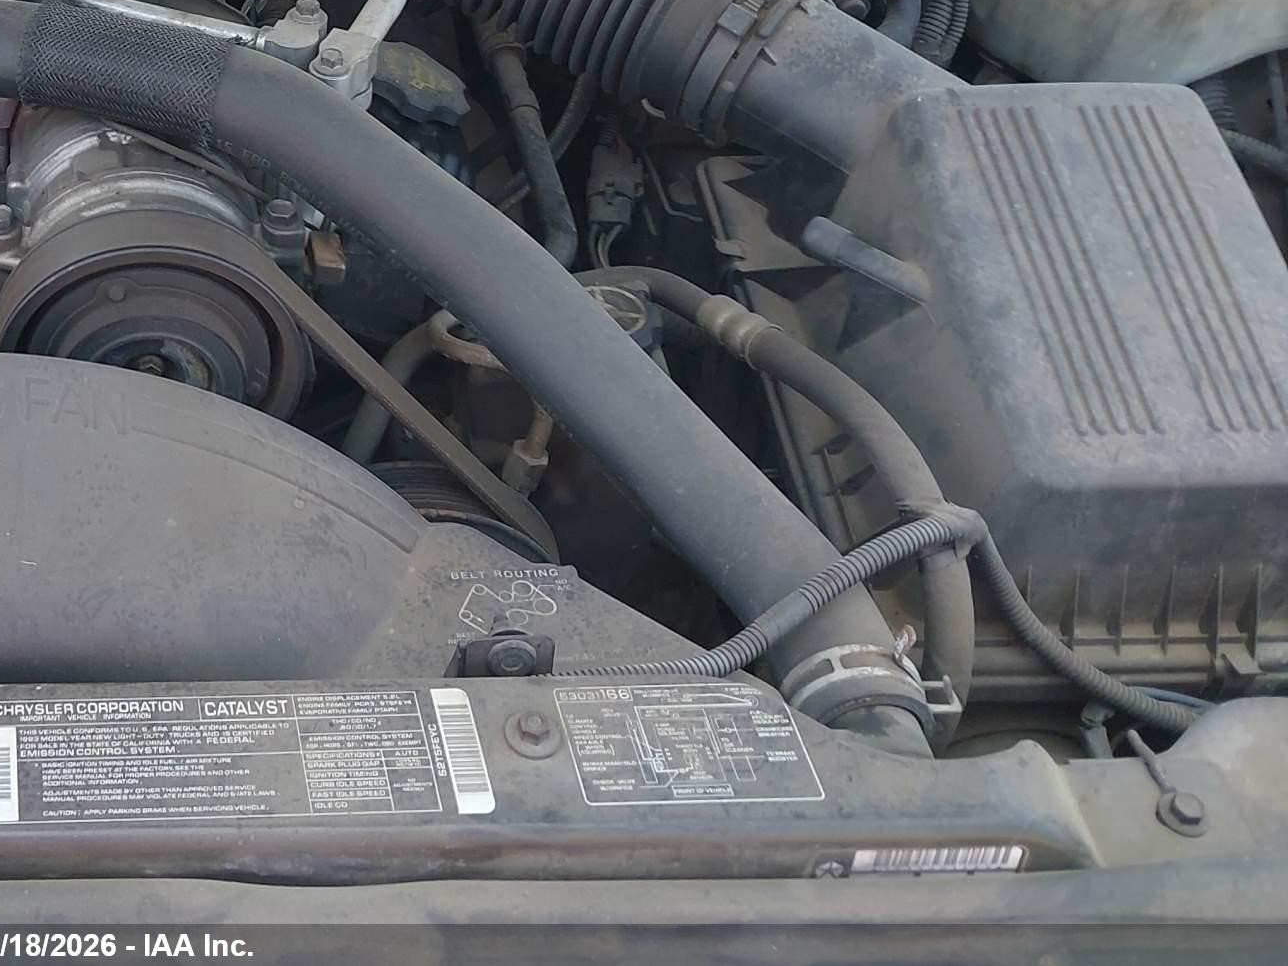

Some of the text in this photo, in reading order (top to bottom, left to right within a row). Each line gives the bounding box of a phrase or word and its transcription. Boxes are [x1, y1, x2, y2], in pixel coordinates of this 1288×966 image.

[23, 375, 129, 436] FAN
[450, 568, 560, 580] BELT ROUTING
[76, 699, 185, 715] CORPORATION
[204, 699, 289, 717] CATALYST
[19, 715, 61, 723] IMPORTANT
[103, 711, 152, 722] INFORMATION
[206, 736, 256, 744] FEDERAL
[20, 748, 75, 758] EMISSION
[76, 747, 127, 756] CONTROL
